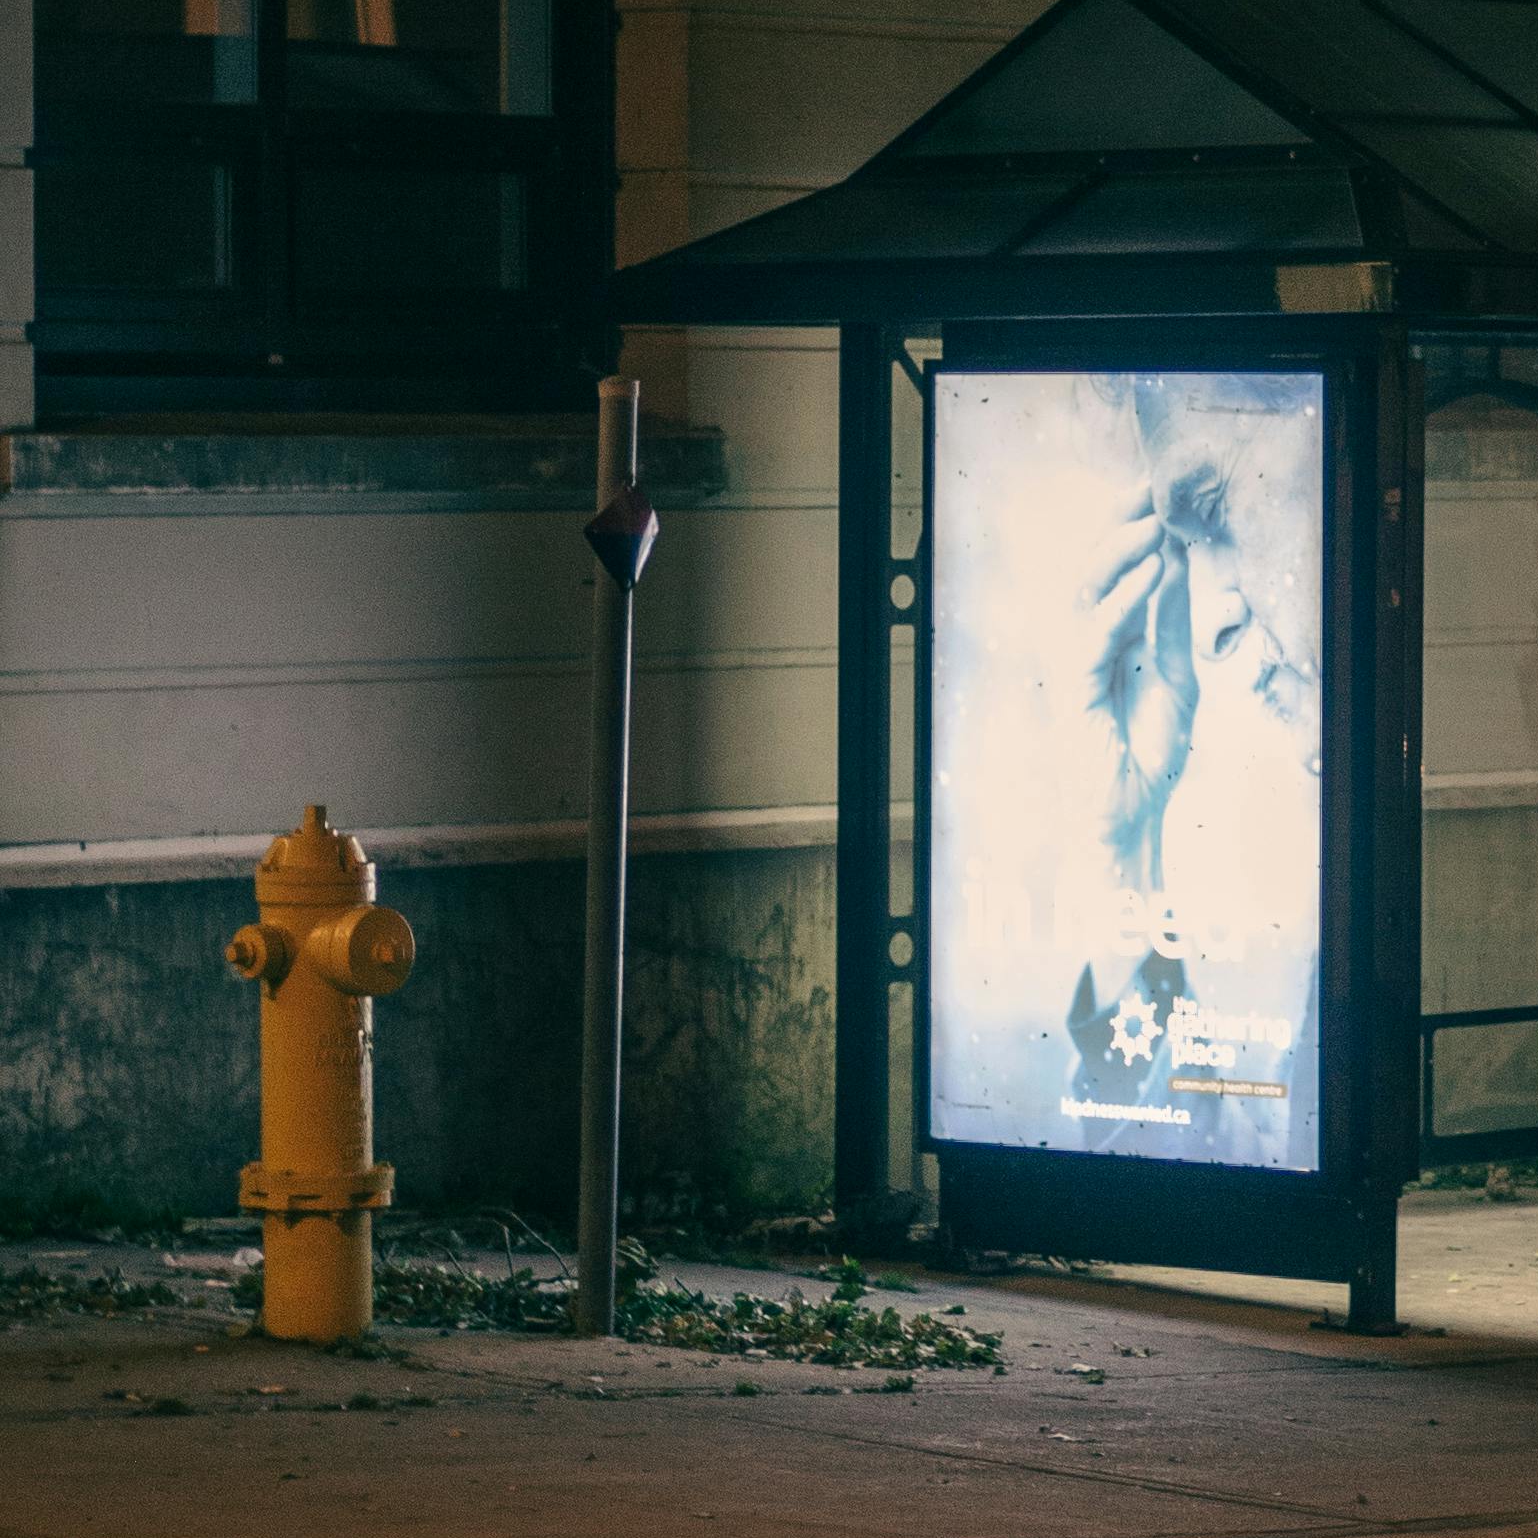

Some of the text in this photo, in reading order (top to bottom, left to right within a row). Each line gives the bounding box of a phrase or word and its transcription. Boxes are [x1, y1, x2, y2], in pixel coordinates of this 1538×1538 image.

[1171, 1036, 1236, 1069] place
[1171, 1079, 1221, 1094] community
[1223, 1081, 1253, 1094] health
